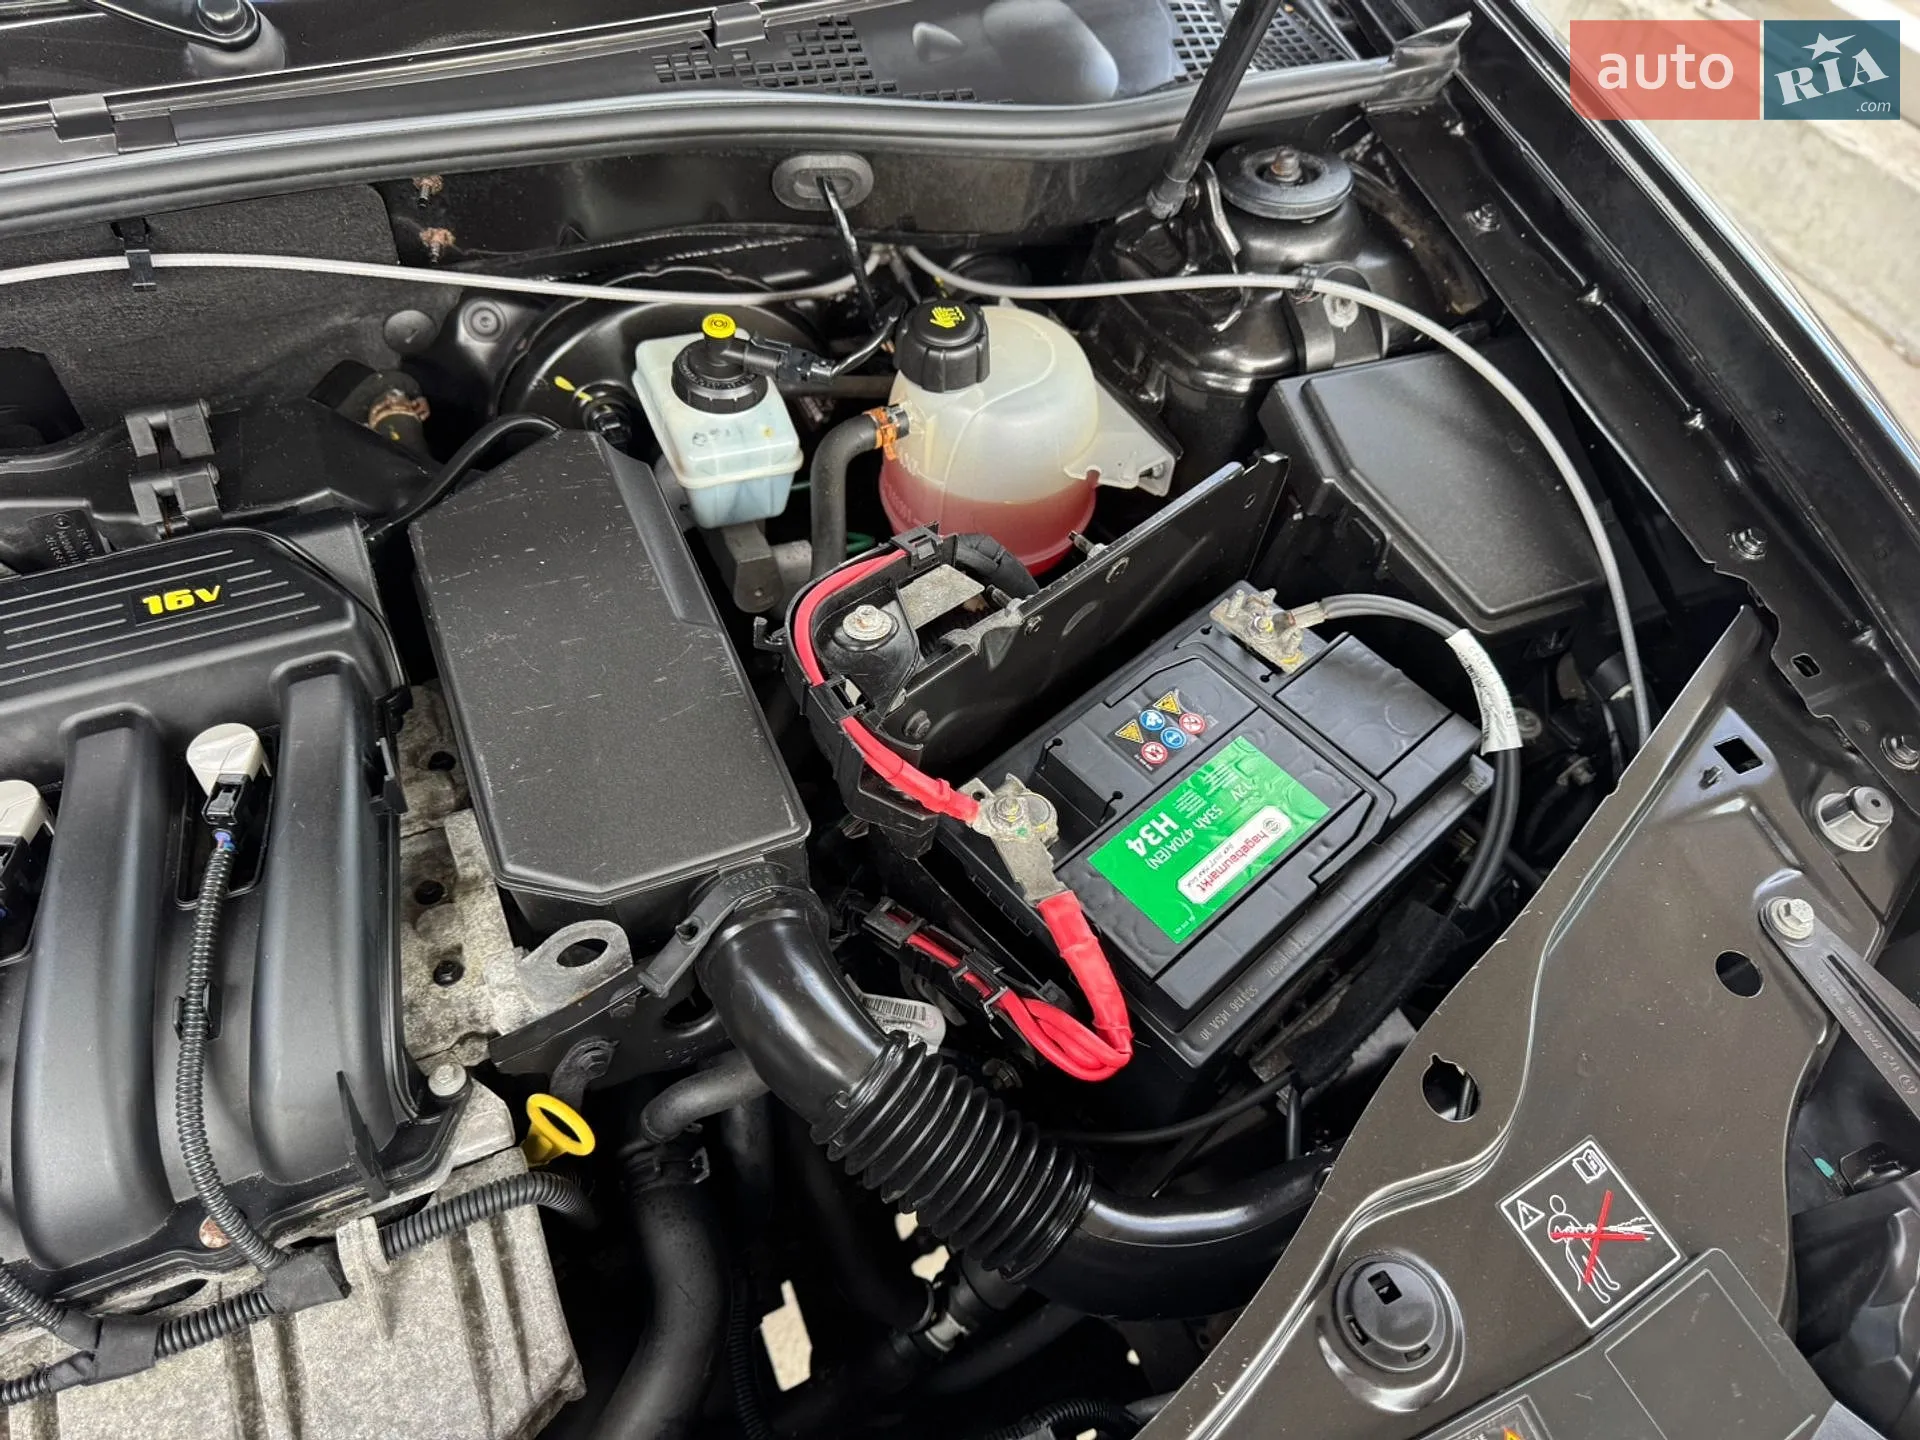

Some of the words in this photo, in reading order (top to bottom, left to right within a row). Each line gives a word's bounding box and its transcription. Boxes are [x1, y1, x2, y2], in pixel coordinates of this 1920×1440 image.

[142, 584, 221, 615] 16V
[1230, 781, 1255, 802] 12V
[1125, 811, 1180, 857] H34
[1192, 803, 1224, 829] 53Ah
[1146, 827, 1195, 871] 470A(EN)
[1196, 829, 1270, 893] hagebaumarkt
